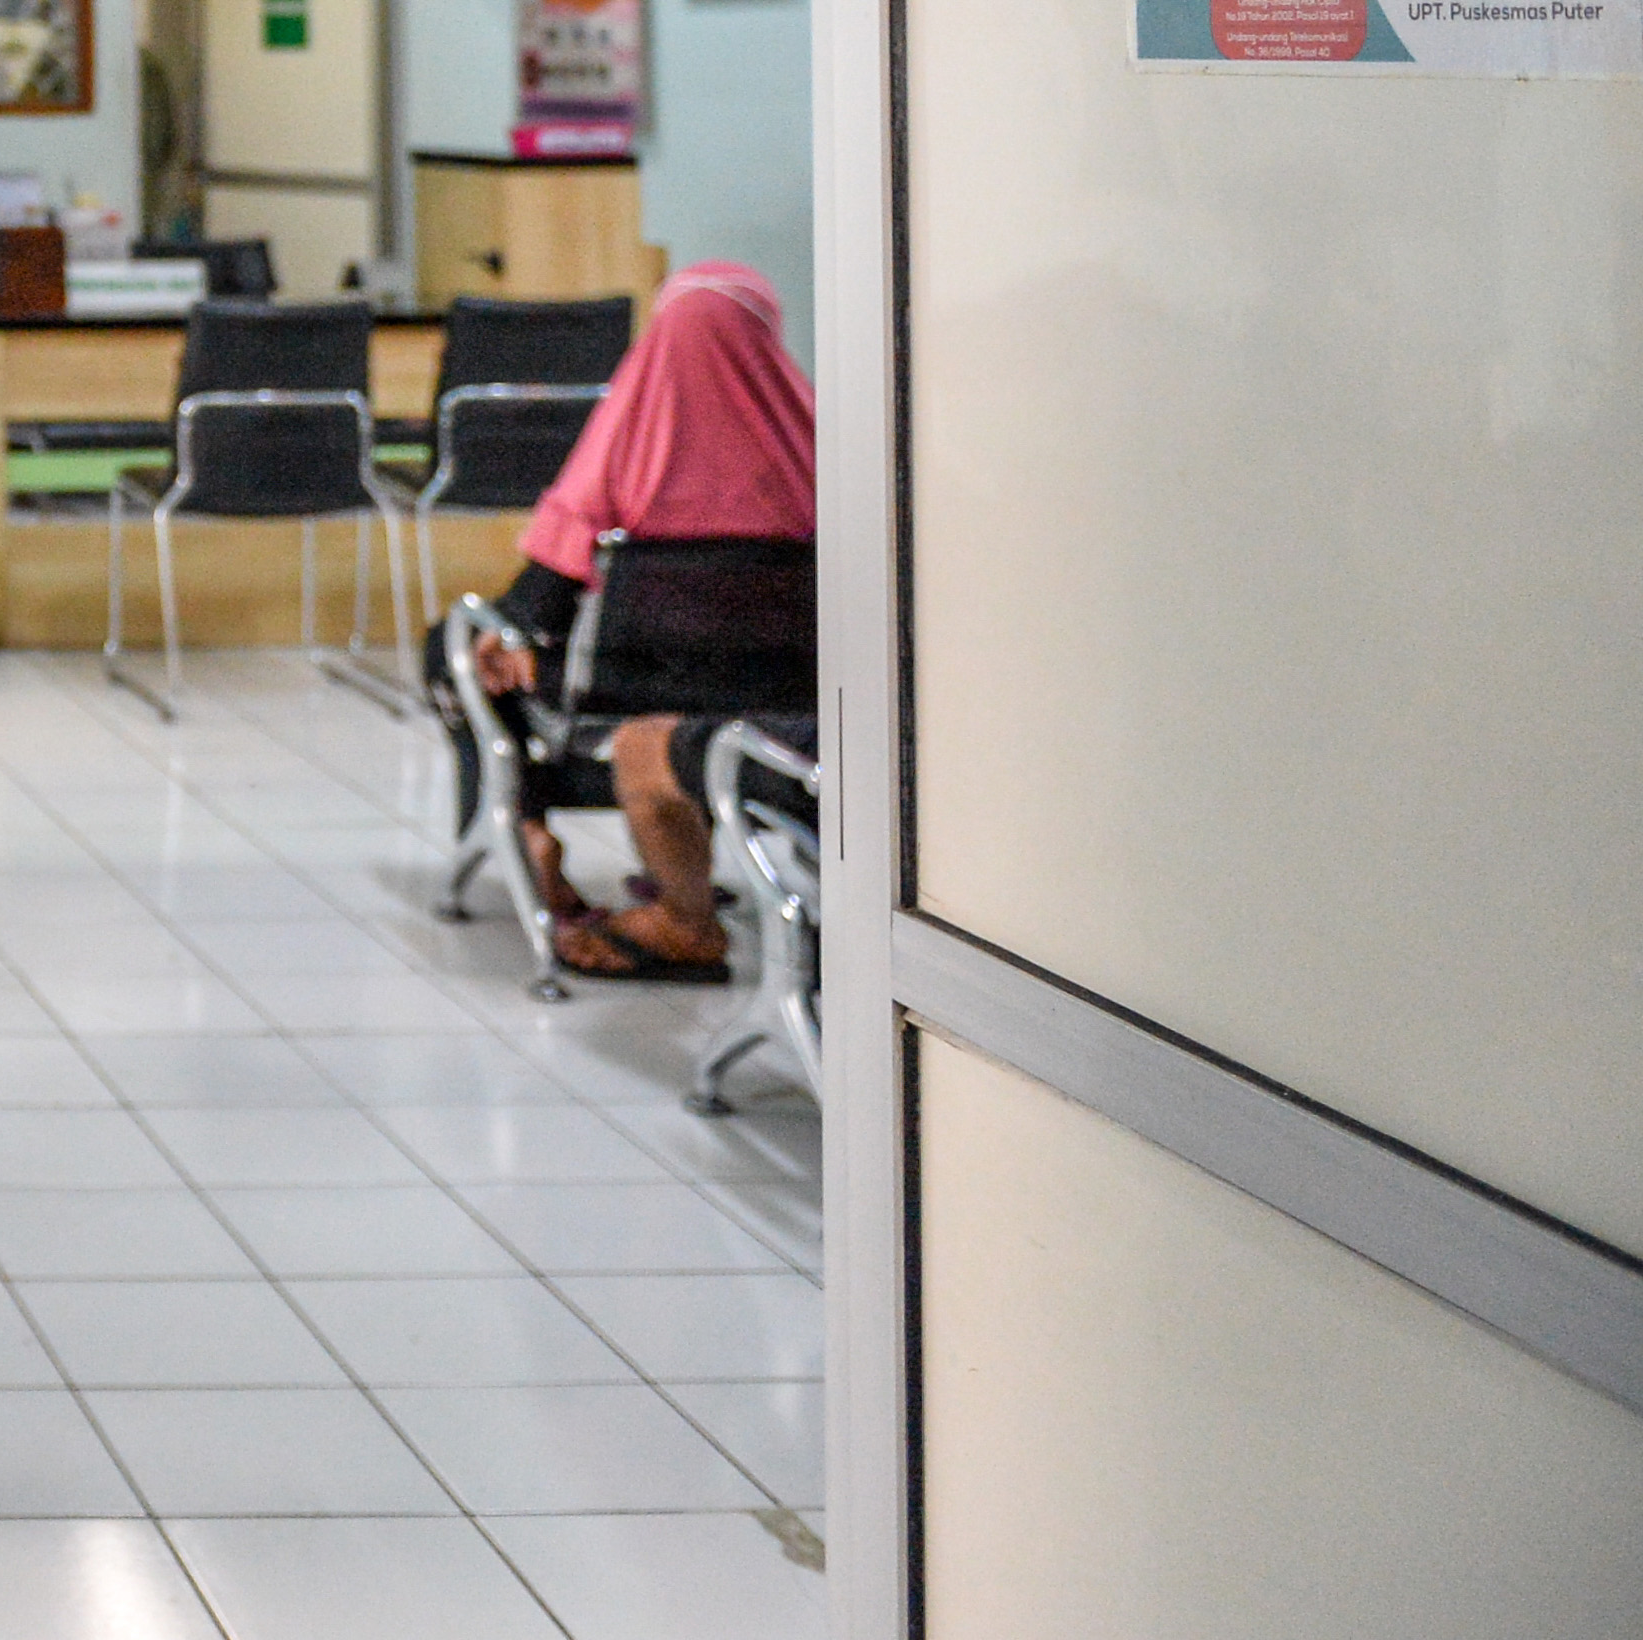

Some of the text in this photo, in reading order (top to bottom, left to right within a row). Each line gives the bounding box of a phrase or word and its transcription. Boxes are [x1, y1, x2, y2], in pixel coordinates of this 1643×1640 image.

[1408, 1, 1603, 21] UPT. Puskesmas Puter
